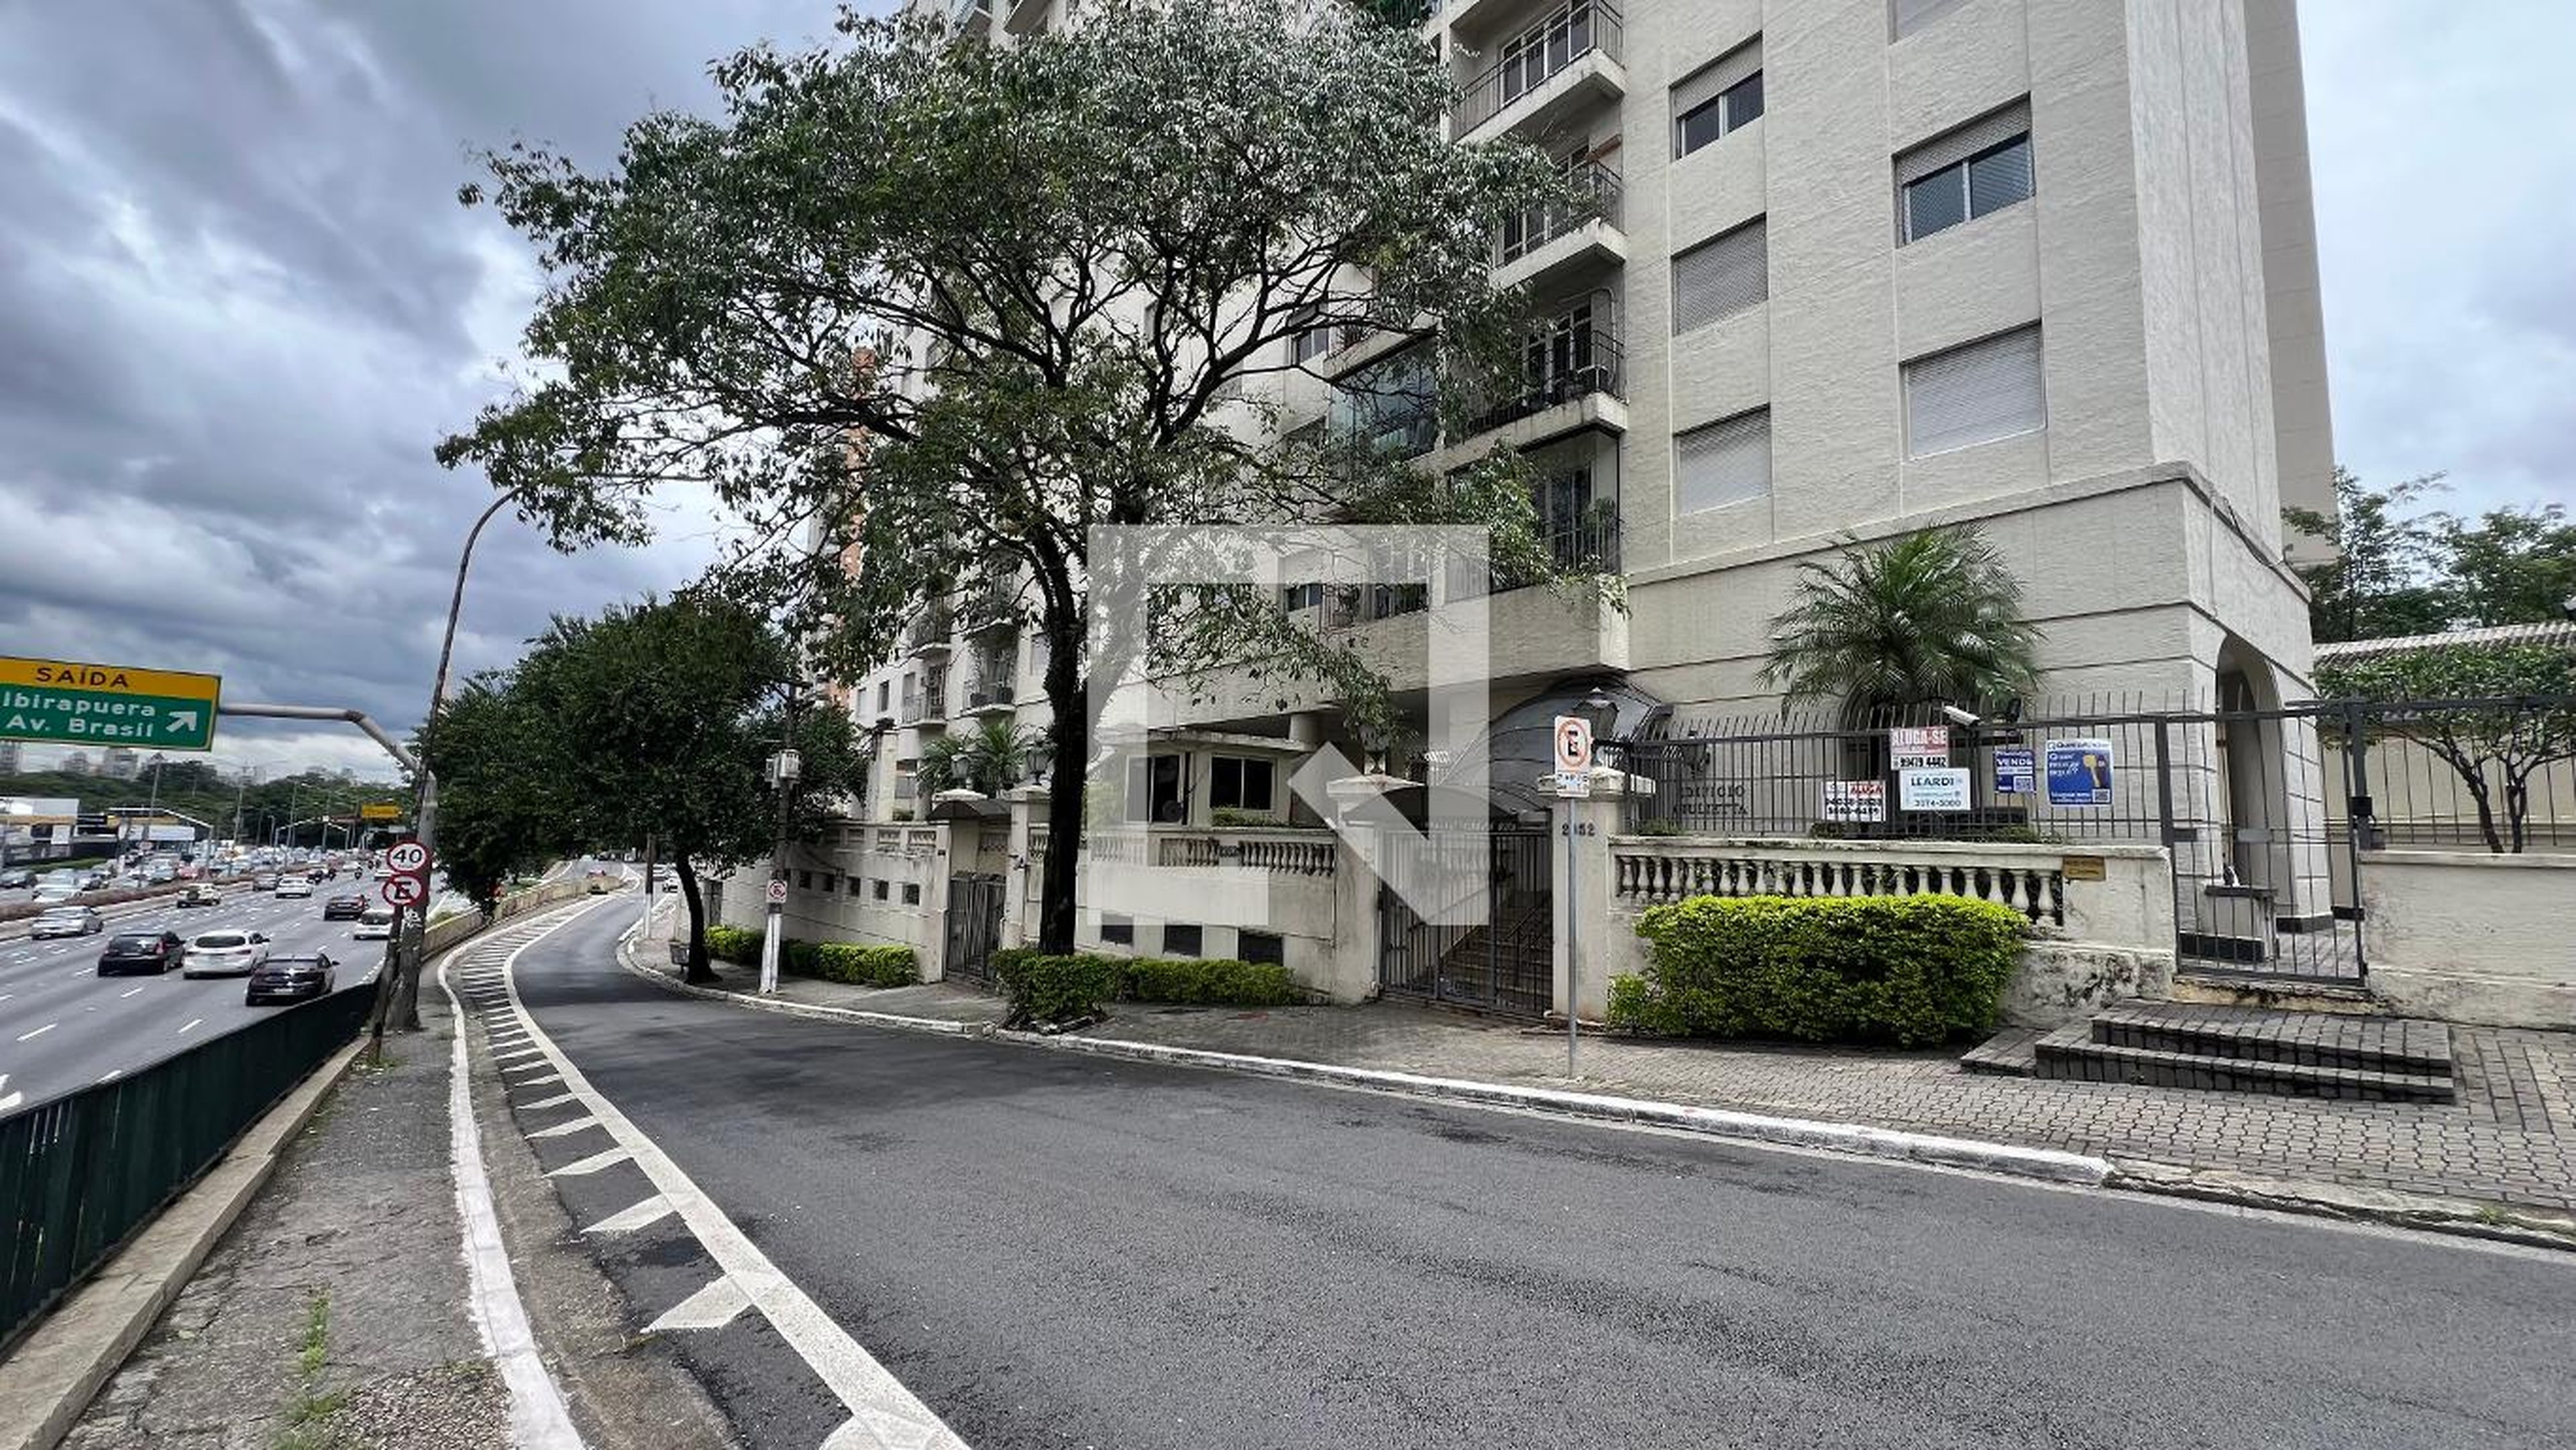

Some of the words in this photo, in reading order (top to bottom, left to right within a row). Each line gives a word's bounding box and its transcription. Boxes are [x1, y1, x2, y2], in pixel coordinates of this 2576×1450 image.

[3, 691, 156, 717] Ibirapuera
[6, 714, 51, 731] Av.
[68, 717, 154, 737] Brasil
[1911, 777, 1955, 786] LEARDI
[392, 849, 422, 864] 40
